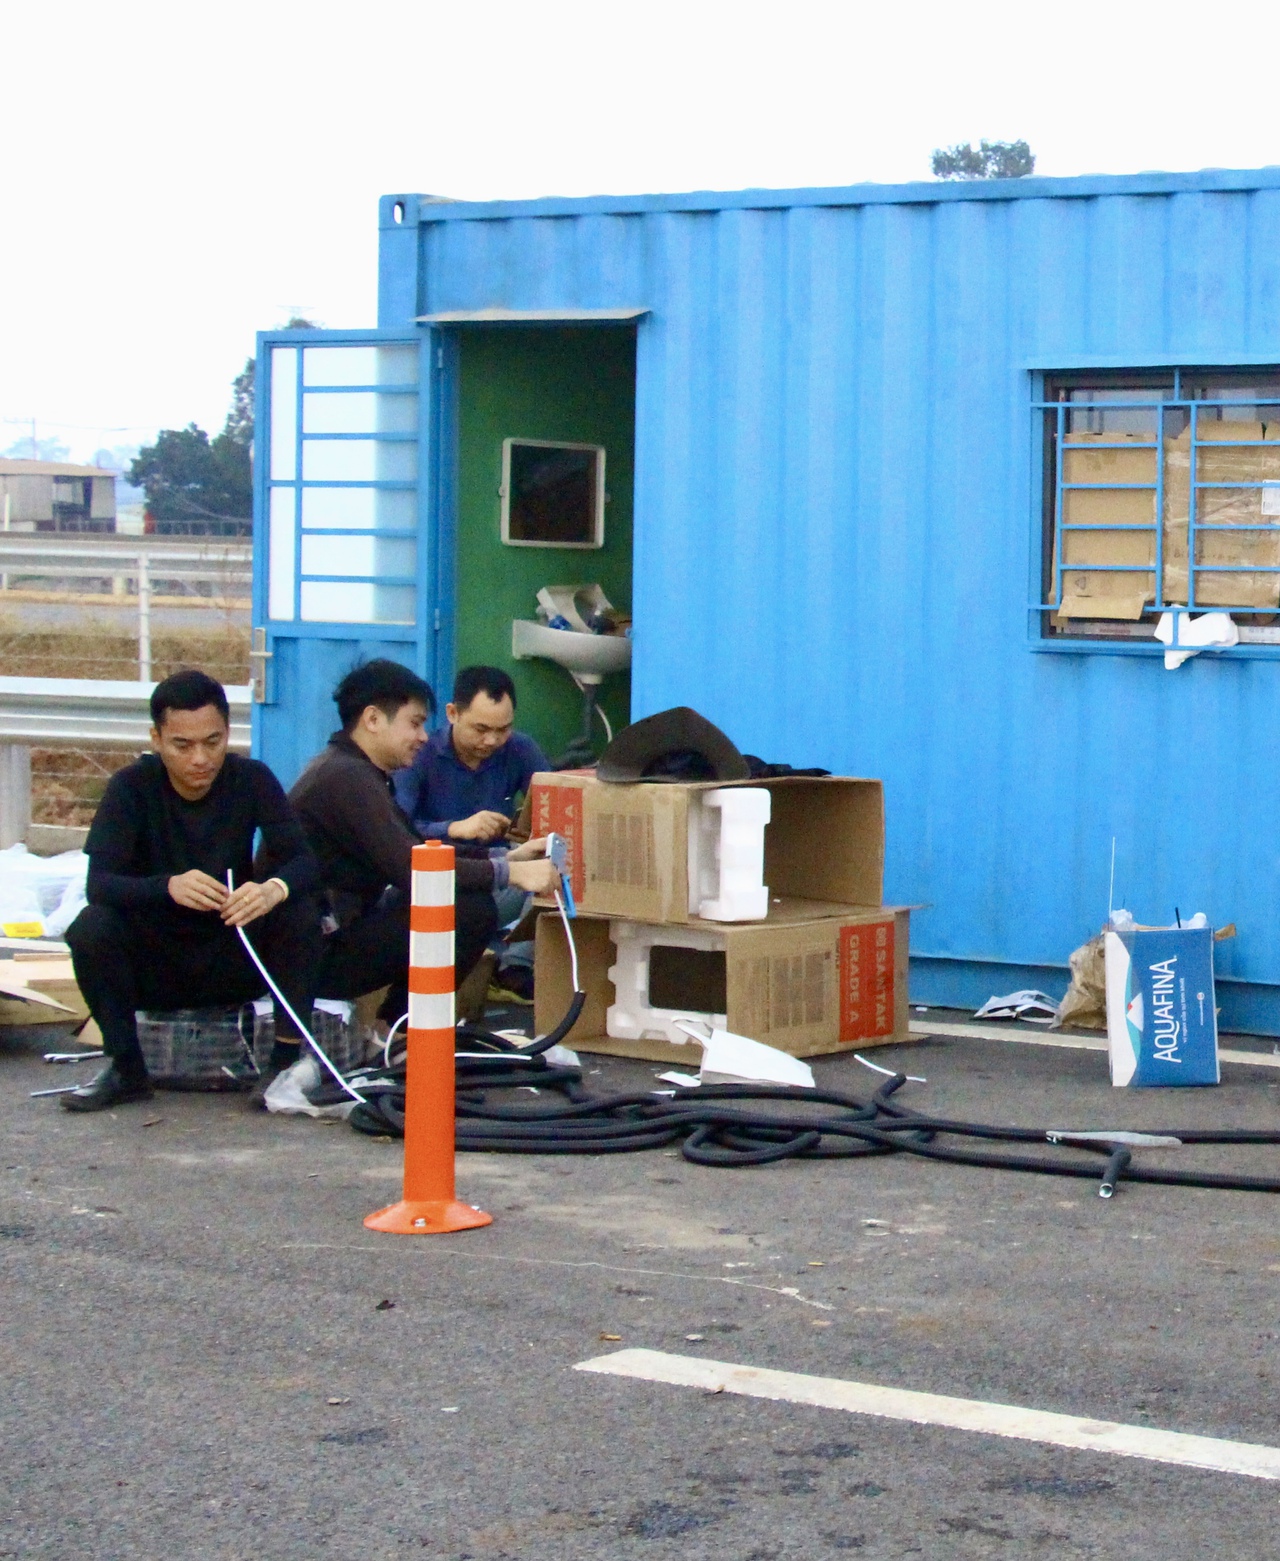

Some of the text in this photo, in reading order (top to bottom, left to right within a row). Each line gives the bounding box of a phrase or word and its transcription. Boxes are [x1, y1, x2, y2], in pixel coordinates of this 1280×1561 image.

[849, 933, 860, 1024] GRADE A
[876, 948, 887, 1031] SANTAK
[1149, 957, 1182, 1064] AQUAFINA
